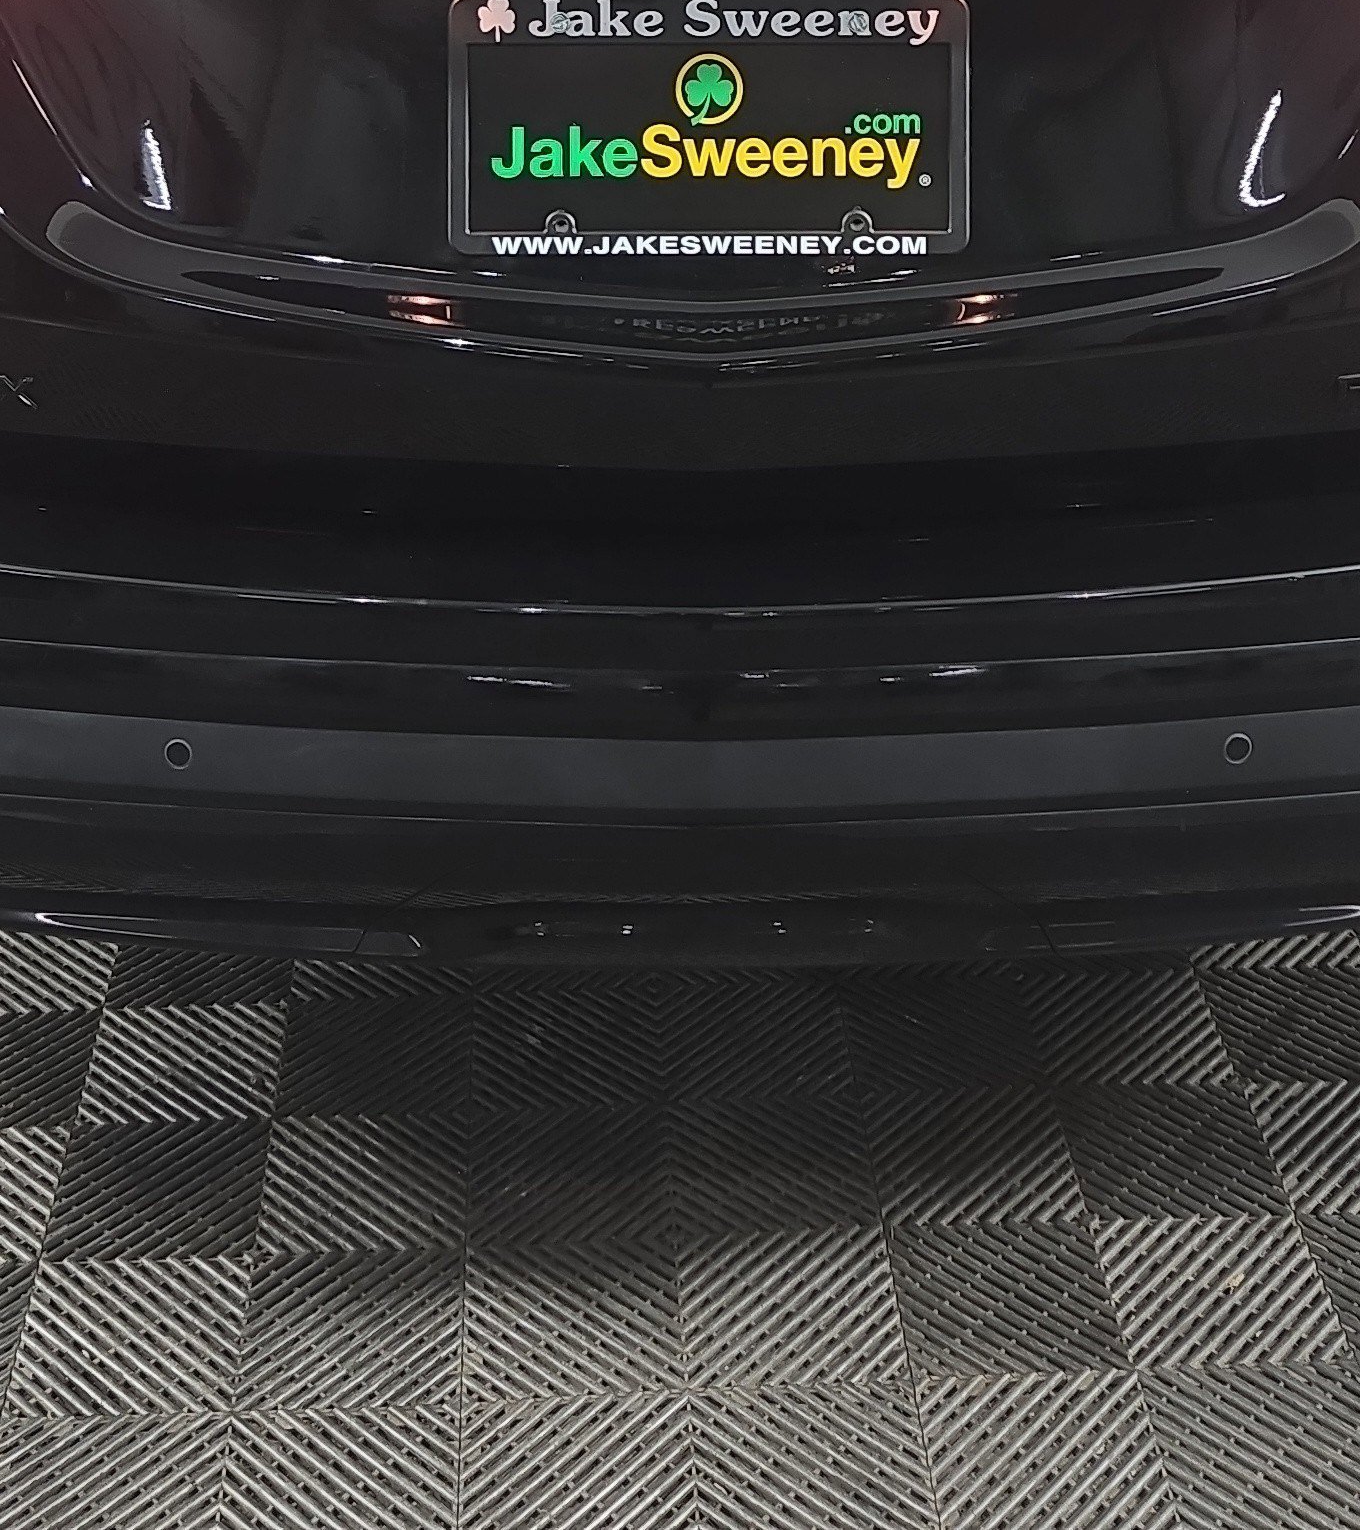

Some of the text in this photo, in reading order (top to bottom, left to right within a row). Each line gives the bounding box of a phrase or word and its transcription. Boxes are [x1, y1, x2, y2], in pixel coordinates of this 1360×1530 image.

[491, 109, 922, 189] JakeSweeney .com
[491, 235, 928, 257] WWW.JAKESWEENEY.COM
